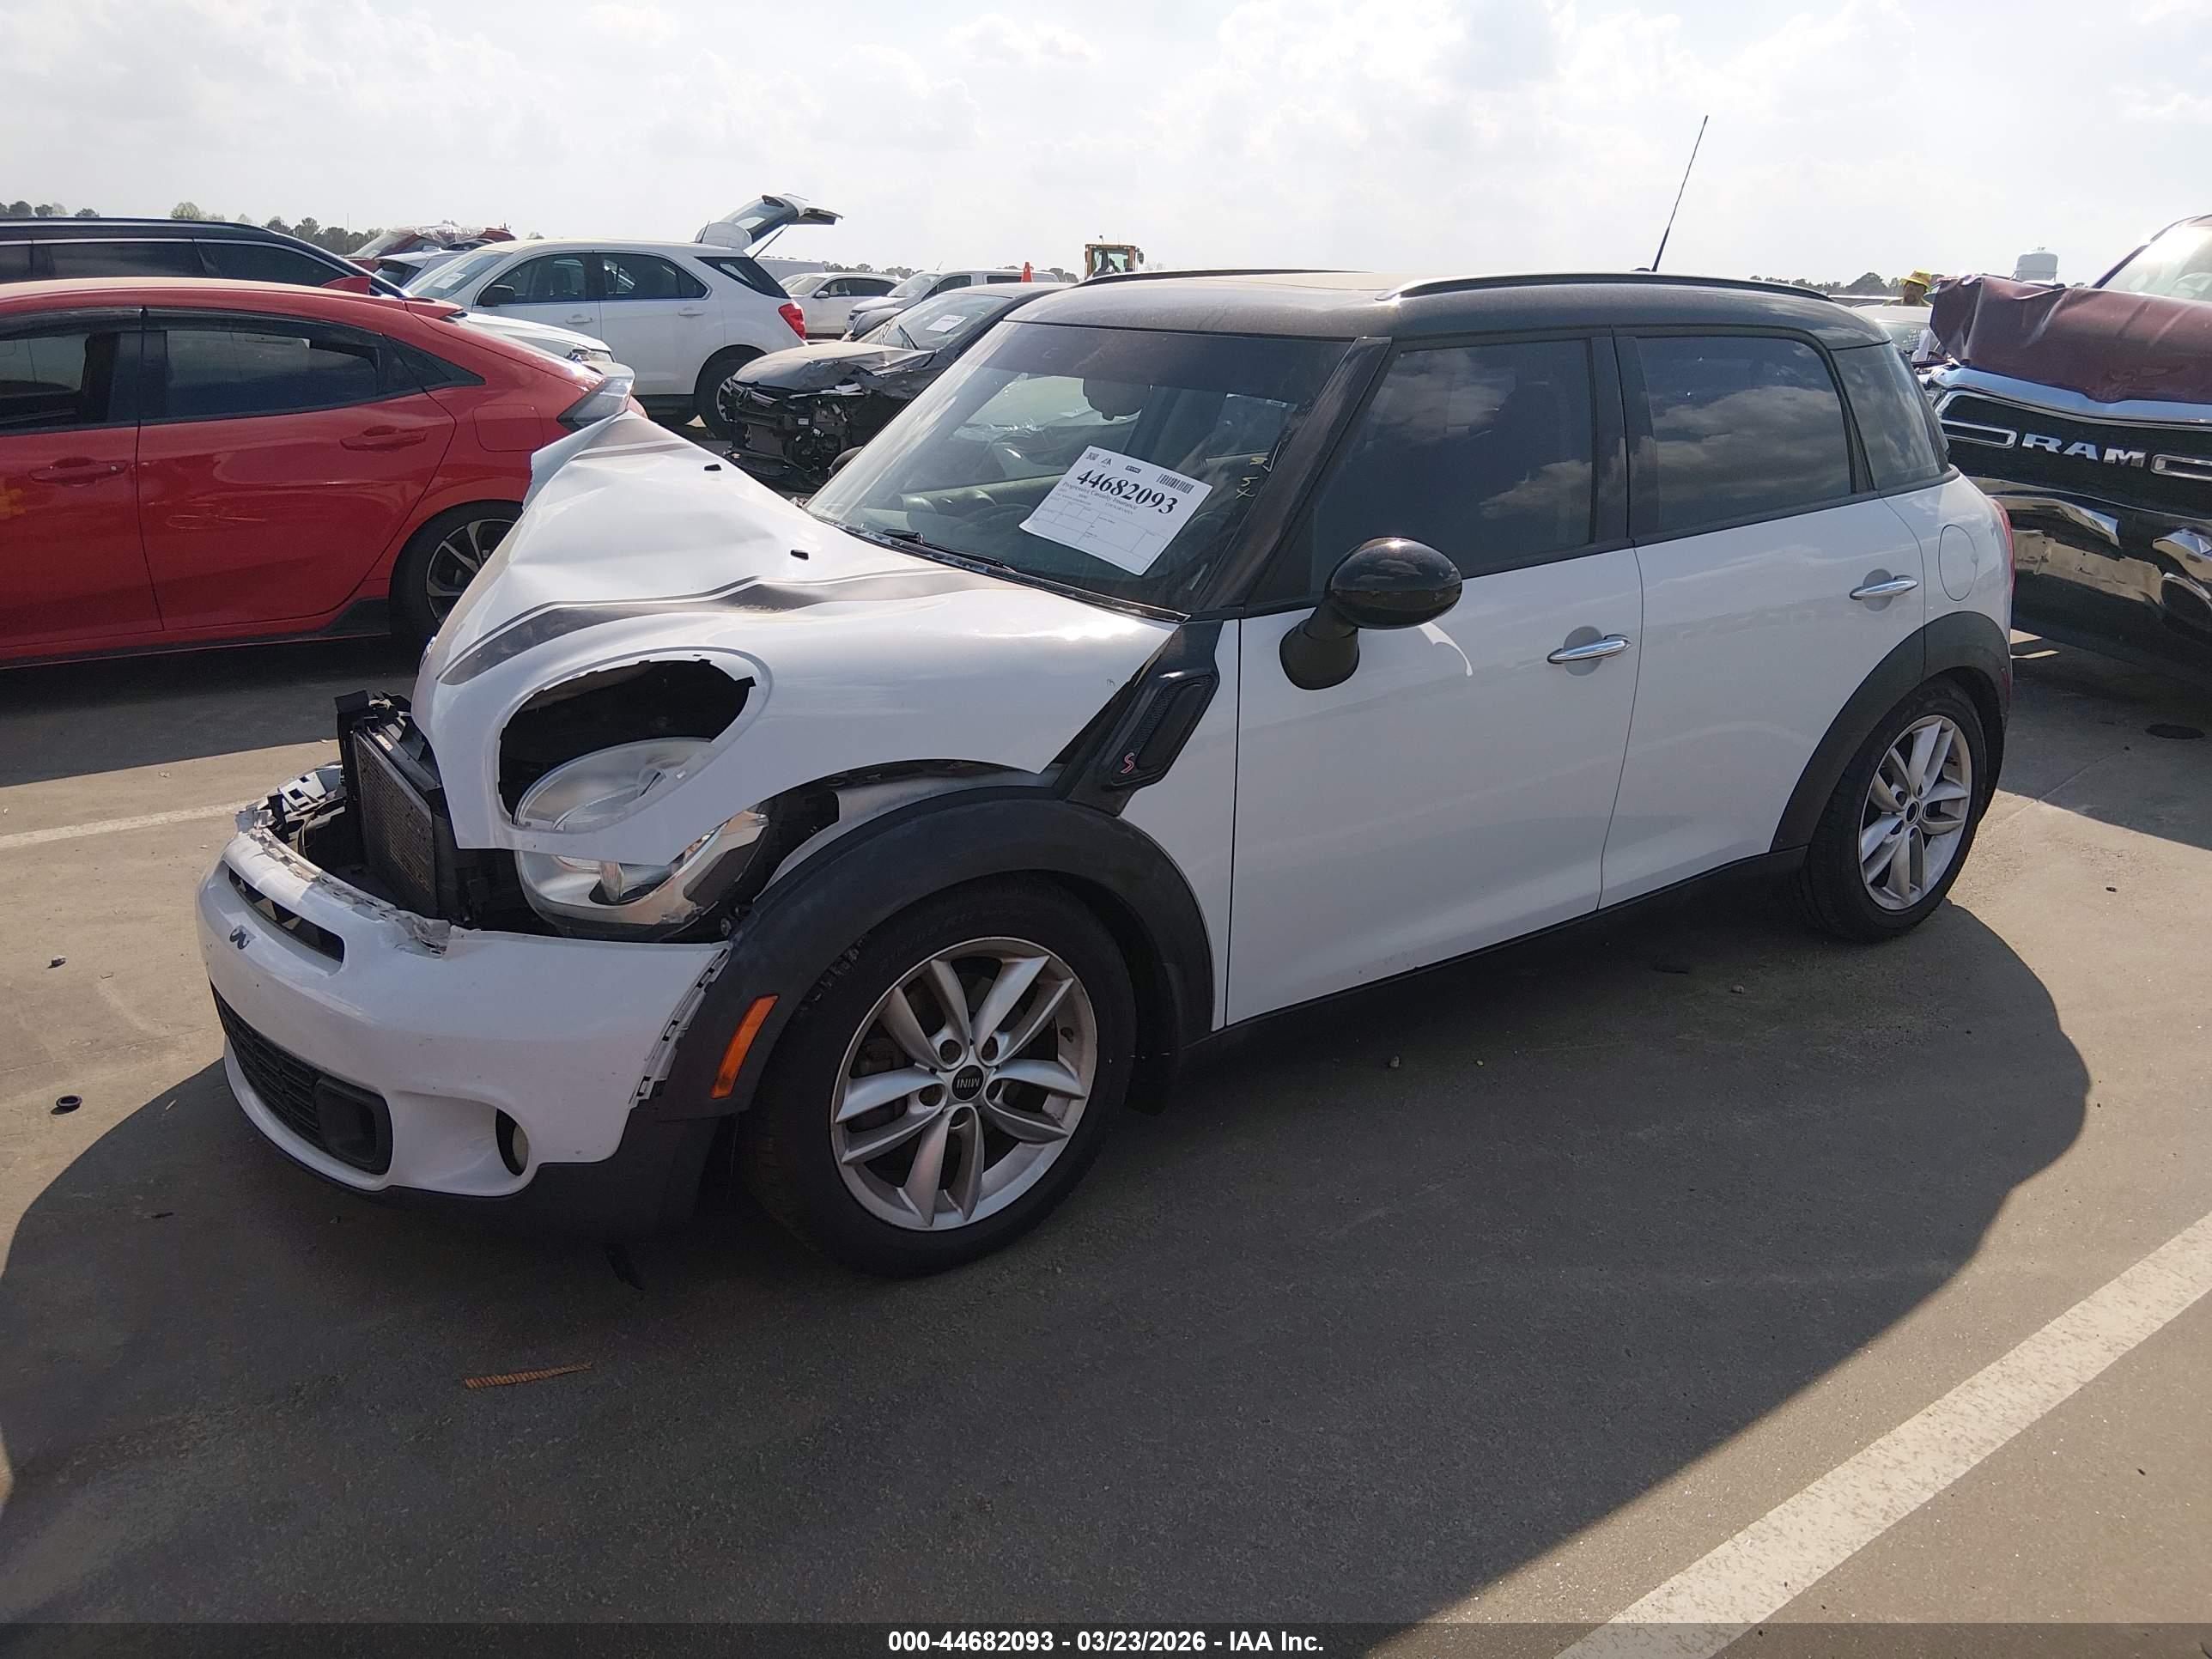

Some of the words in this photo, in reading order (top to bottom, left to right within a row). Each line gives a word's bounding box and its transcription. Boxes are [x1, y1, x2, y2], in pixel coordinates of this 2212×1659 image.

[2022, 433, 2148, 468] RAM
[1076, 469, 1179, 515] 44682093
[1121, 752, 1134, 773] S
[957, 1078, 980, 1089] MINI
